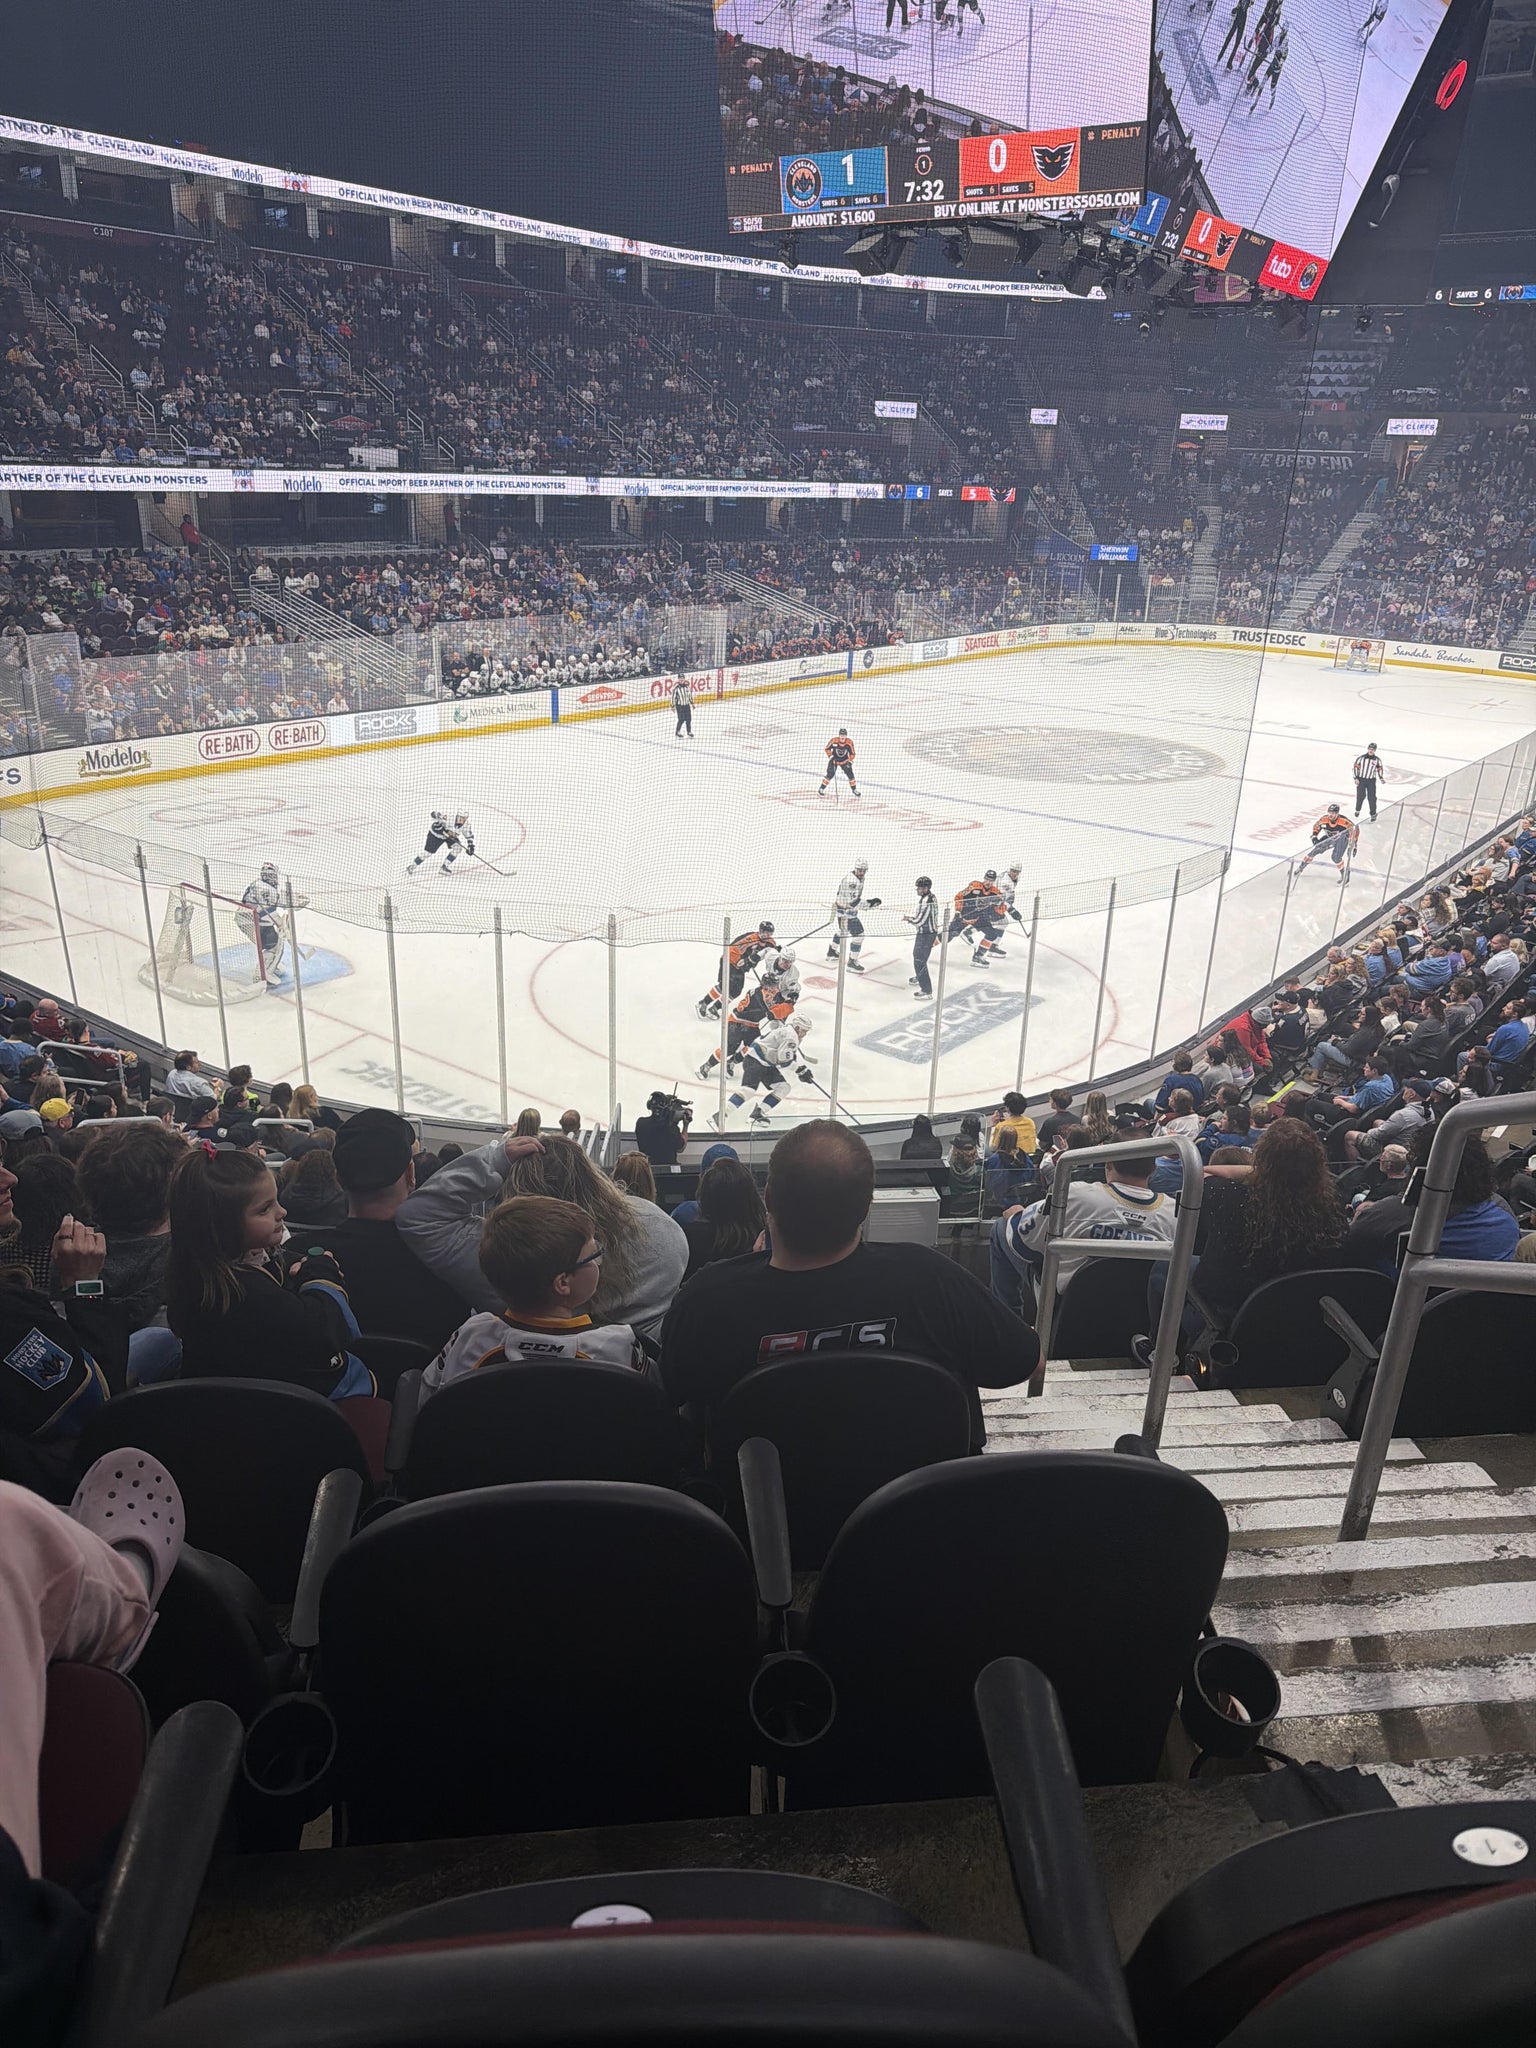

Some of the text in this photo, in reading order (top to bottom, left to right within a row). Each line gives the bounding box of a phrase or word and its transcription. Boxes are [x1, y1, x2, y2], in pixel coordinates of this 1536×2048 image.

[1101, 127, 1141, 140] PENALTY
[40, 124, 57, 136] OF
[61, 128, 83, 141] THE
[88, 135, 155, 157] CLEVELAND
[161, 152, 218, 173] MONSTERS
[988, 138, 1007, 173] 0
[232, 167, 264, 184] Modelo
[741, 162, 773, 174] PENALTY
[790, 161, 817, 175] CLEVELAND
[842, 153, 854, 185] 1
[904, 180, 945, 202] 7:32
[966, 187, 983, 195] SHOTS
[1002, 185, 1019, 193] SAVES
[821, 198, 838, 206] SHOTS
[855, 196, 870, 204] SAVES
[934, 192, 1140, 218] BUY ONLINE AT MONSTERS5050.COM
[338, 187, 581, 245] OFFICIAL IMPORT BEER PARTNER OF THE CLEVELAND MONSTERS
[791, 210, 876, 227] AMOUNT: $1,600
[1146, 198, 1160, 225] 1
[1198, 217, 1212, 244] 0
[1161, 231, 1179, 249] 7:32
[650, 247, 862, 284] OFFICIAL IMPORT BEER PARTNER OF THE CLEVELAND MONSTERS
[947, 282, 981, 292] OFFICIAL
[981, 283, 1010, 292] IMPORT
[1010, 283, 1030, 291] BEER
[1435, 288, 1493, 300] 6 SAVES 6
[890, 406, 915, 414] CLIFFS
[1406, 423, 1435, 431] CLIFFS
[46, 474, 61, 483] OF
[64, 473, 86, 483] THE
[88, 474, 151, 484] CLEVELAND
[154, 475, 208, 485] MONSTERS
[283, 476, 322, 492] Modelo
[339, 478, 566, 490] OFFICIAL IMPORT BEER PARTNER OF THE CLEVELAND MONSTERS
[660, 484, 685, 492] OFFICIAL
[685, 484, 705, 492] IMPORT
[705, 484, 718, 492] BEER
[720, 485, 741, 493] PARTNER
[916, 489, 923, 498] 6
[969, 489, 976, 499] 5
[1175, 627, 1217, 641] Technologies
[1232, 630, 1307, 646] TRUSTEDSEC
[965, 634, 1000, 651] SEATGEEK
[85, 746, 142, 771] Modelo
[1122, 1212, 1147, 1221] CCM
[11, 1334, 38, 1361] MONSTERS
[15, 1336, 46, 1368] HOCKEY
[518, 1342, 566, 1353] CCM
[26, 1346, 47, 1368] CLUB
